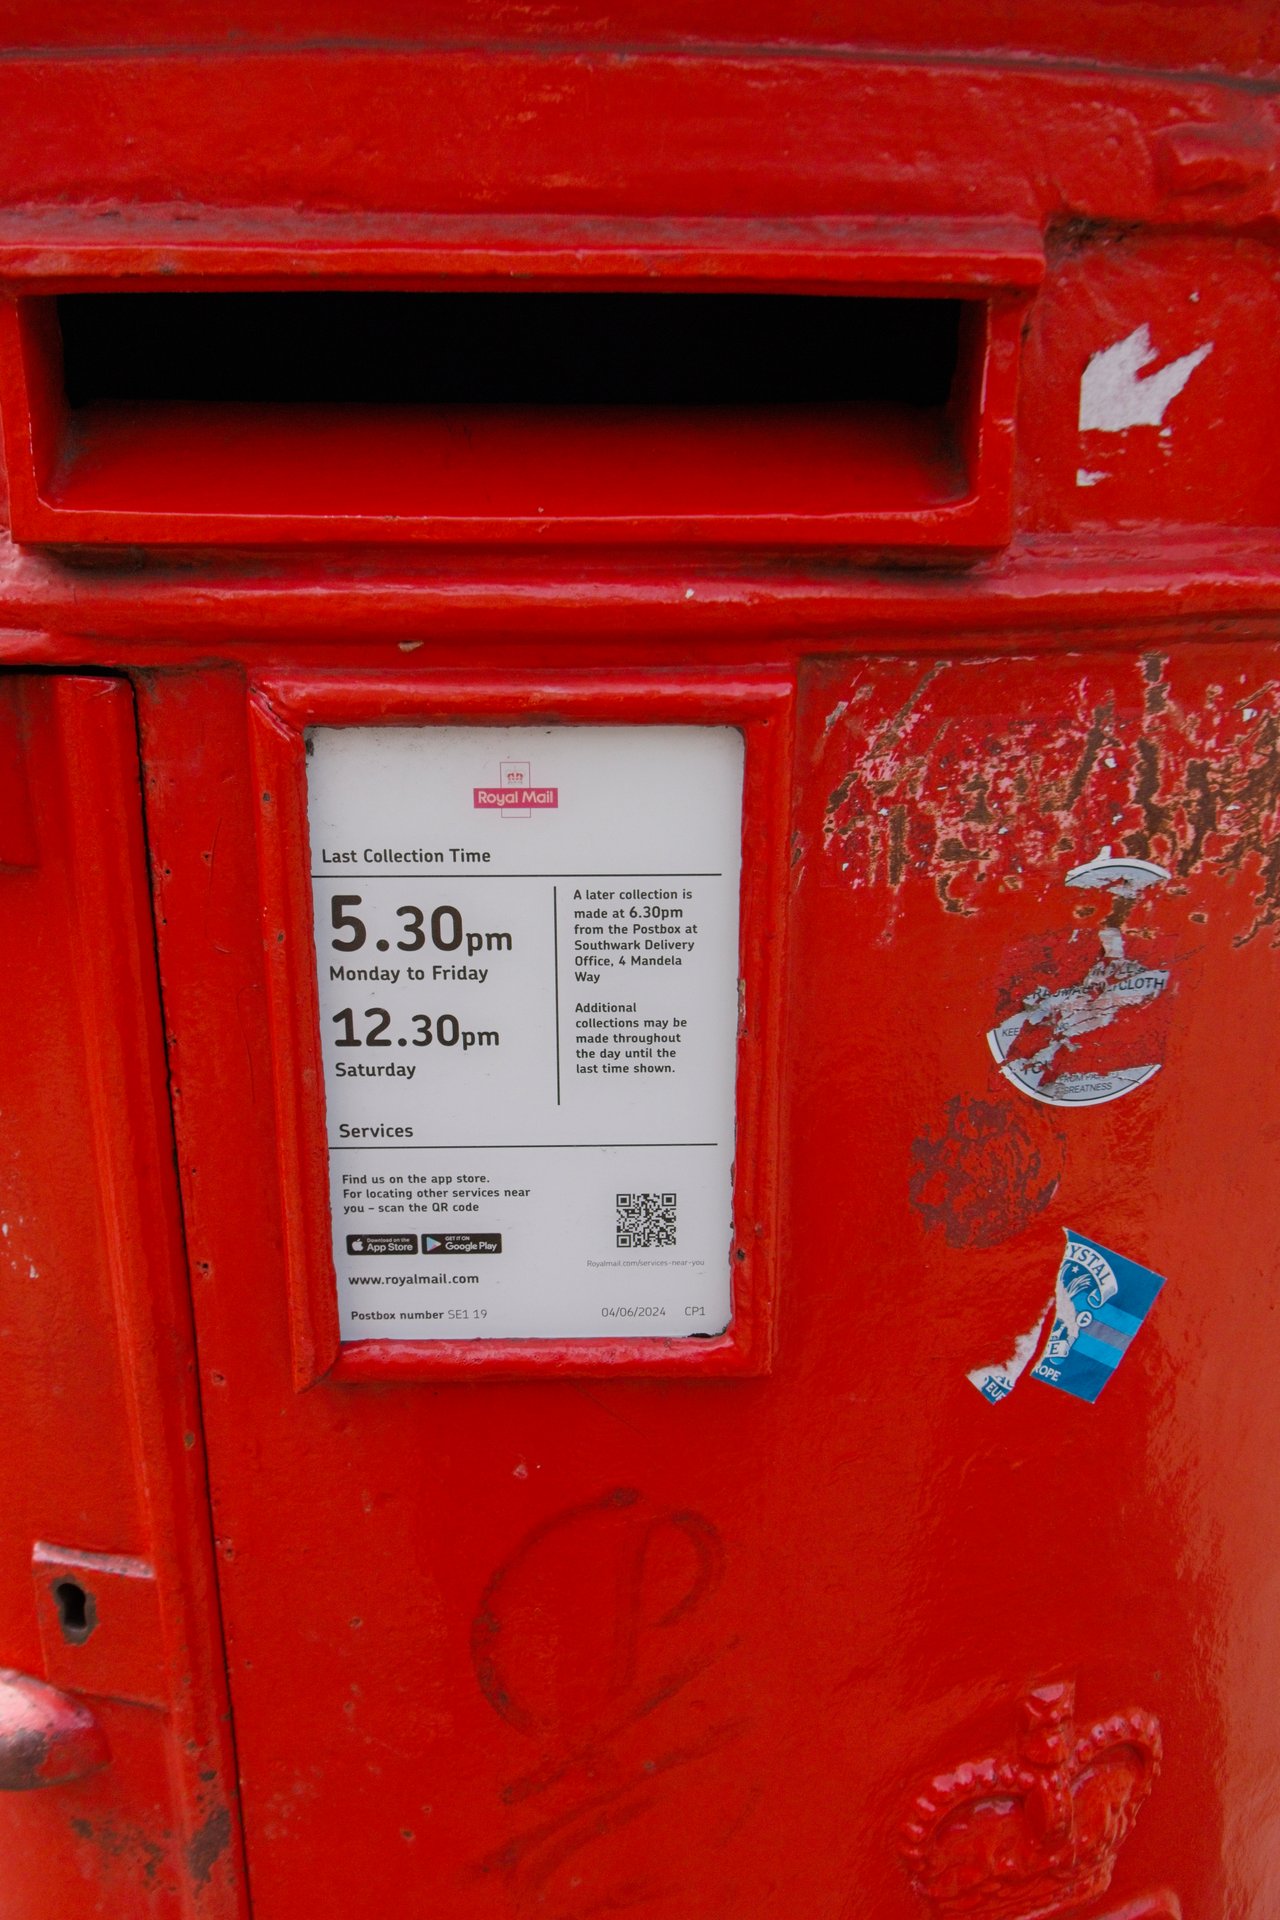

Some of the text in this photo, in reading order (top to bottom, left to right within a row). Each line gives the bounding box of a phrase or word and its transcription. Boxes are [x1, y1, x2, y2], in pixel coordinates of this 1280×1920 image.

[478, 790, 554, 807] Royal Mail
[321, 847, 491, 864] Last Collection Time
[573, 888, 693, 901] A later collection is
[573, 905, 684, 920] made at 6.30pm
[330, 894, 513, 958] 5.30pm
[573, 923, 699, 935] from the Postbox at
[574, 938, 695, 952] Southwark Delivery
[574, 955, 683, 968] Office, 4 Mandela
[329, 964, 489, 985] Monday to Friday
[574, 971, 601, 985] Way
[574, 1002, 637, 1013] Additional
[331, 1006, 500, 1051] 12.30pm
[575, 1017, 688, 1030] collections may be
[575, 1032, 682, 1046] made throughout
[575, 1047, 677, 1061] the day until the
[334, 1061, 417, 1080] Saturday
[576, 1062, 676, 1074] last time shown.
[338, 1122, 414, 1139] Services
[341, 1173, 490, 1186] Find us on the app store.
[342, 1187, 531, 1201] For locating other services near
[343, 1205, 365, 1215] you
[377, 1204, 405, 1213] scan
[408, 1202, 428, 1213] the
[431, 1202, 449, 1213] QR
[452, 1201, 480, 1212] code
[366, 1243, 413, 1253] App Store
[445, 1241, 497, 1252] Google Play
[1066, 1244, 1111, 1286] YSTAL
[347, 1272, 480, 1287] www.royalmail.com
[350, 1309, 488, 1321] Postbox number SE1 19
[601, 1306, 706, 1318] 04/06/2024 CP1
